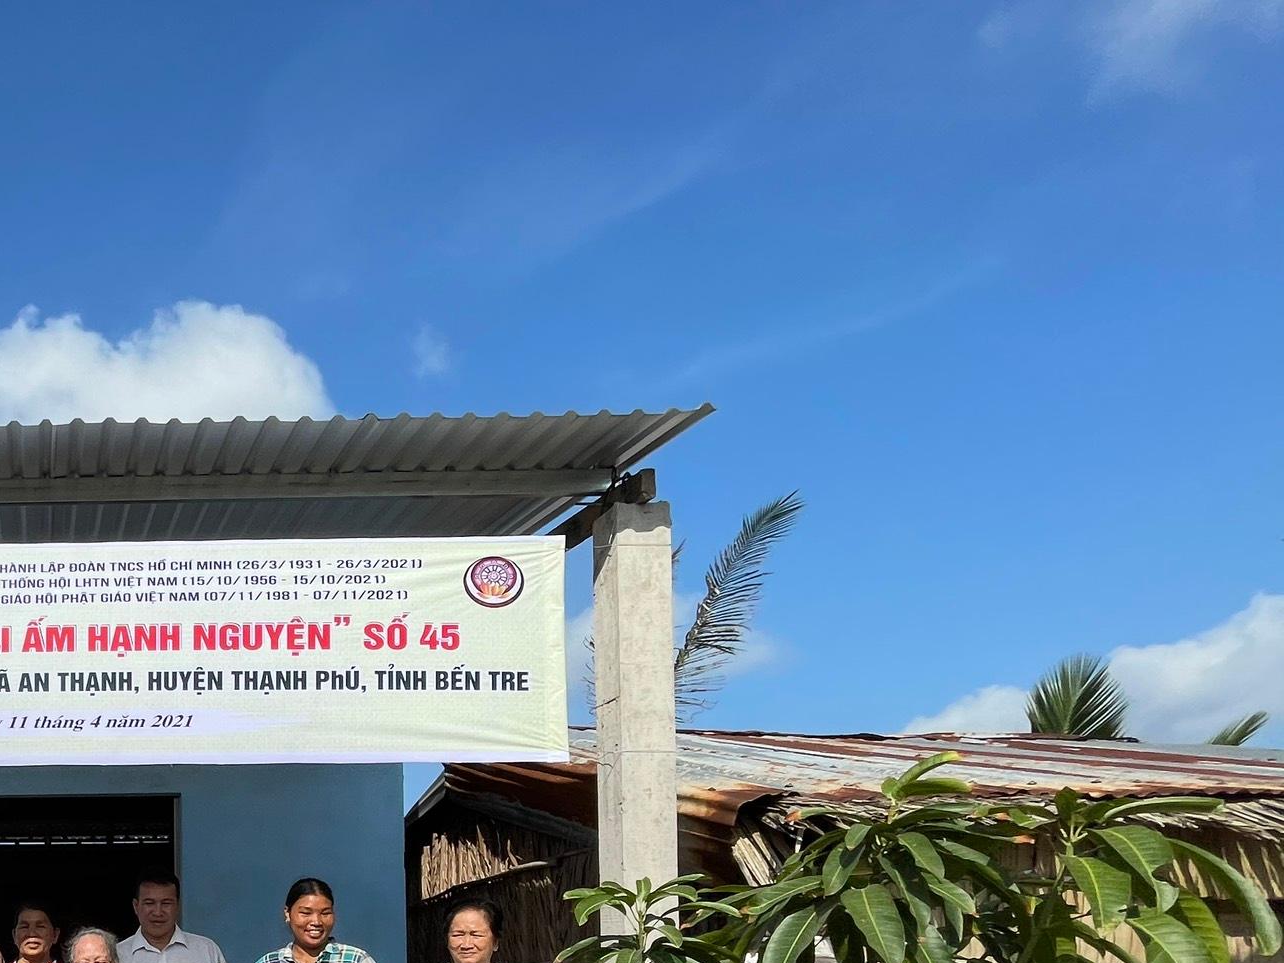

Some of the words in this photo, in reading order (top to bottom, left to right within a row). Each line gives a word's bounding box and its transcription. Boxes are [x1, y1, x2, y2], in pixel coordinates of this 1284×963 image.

[40, 561, 65, 575] LẬP
[69, 560, 105, 572] ĐOÀN
[110, 562, 144, 572] TNCS
[170, 559, 192, 570] CHÍ
[196, 560, 232, 570] MINH
[236, 560, 322, 570] (26/3/1931
[336, 559, 422, 569] 26/3/2021)
[0, 576, 44, 589] THỐNG
[49, 576, 70, 590] HỘI
[75, 578, 110, 588] LHTN
[114, 575, 143, 588] VIỆT
[147, 576, 178, 586] NAM
[182, 576, 277, 586] (15/10/1956
[293, 575, 386, 584] 15/10/2021)
[1, 593, 31, 604] GIÁO
[36, 592, 56, 606] HỘI
[62, 592, 97, 605] PHẬT
[100, 591, 131, 602] GIÁO
[136, 590, 165, 604] VIỆT
[169, 592, 200, 601] NAM
[204, 591, 298, 601] (07/11/1981
[314, 590, 408, 600] 07/11/2021)
[22, 616, 76, 652] ẤM
[88, 622, 182, 657] HẠNH
[193, 614, 352, 656] NGUYỆN”
[363, 612, 410, 650] SỐ
[420, 622, 460, 650] 45
[18, 672, 50, 692] AN
[58, 672, 139, 696] THẠNH,
[148, 666, 223, 695] HUYỆN
[231, 670, 307, 694] THẠNH
[316, 666, 366, 693] PhÚ,
[374, 664, 427, 690] TỈNH
[435, 664, 480, 691] BẾN
[488, 671, 529, 691] TRE
[8, 716, 28, 729] 11
[34, 714, 84, 732] tháng
[90, 716, 101, 728] 4
[106, 714, 145, 728] năm
[151, 714, 193, 728] 2021
